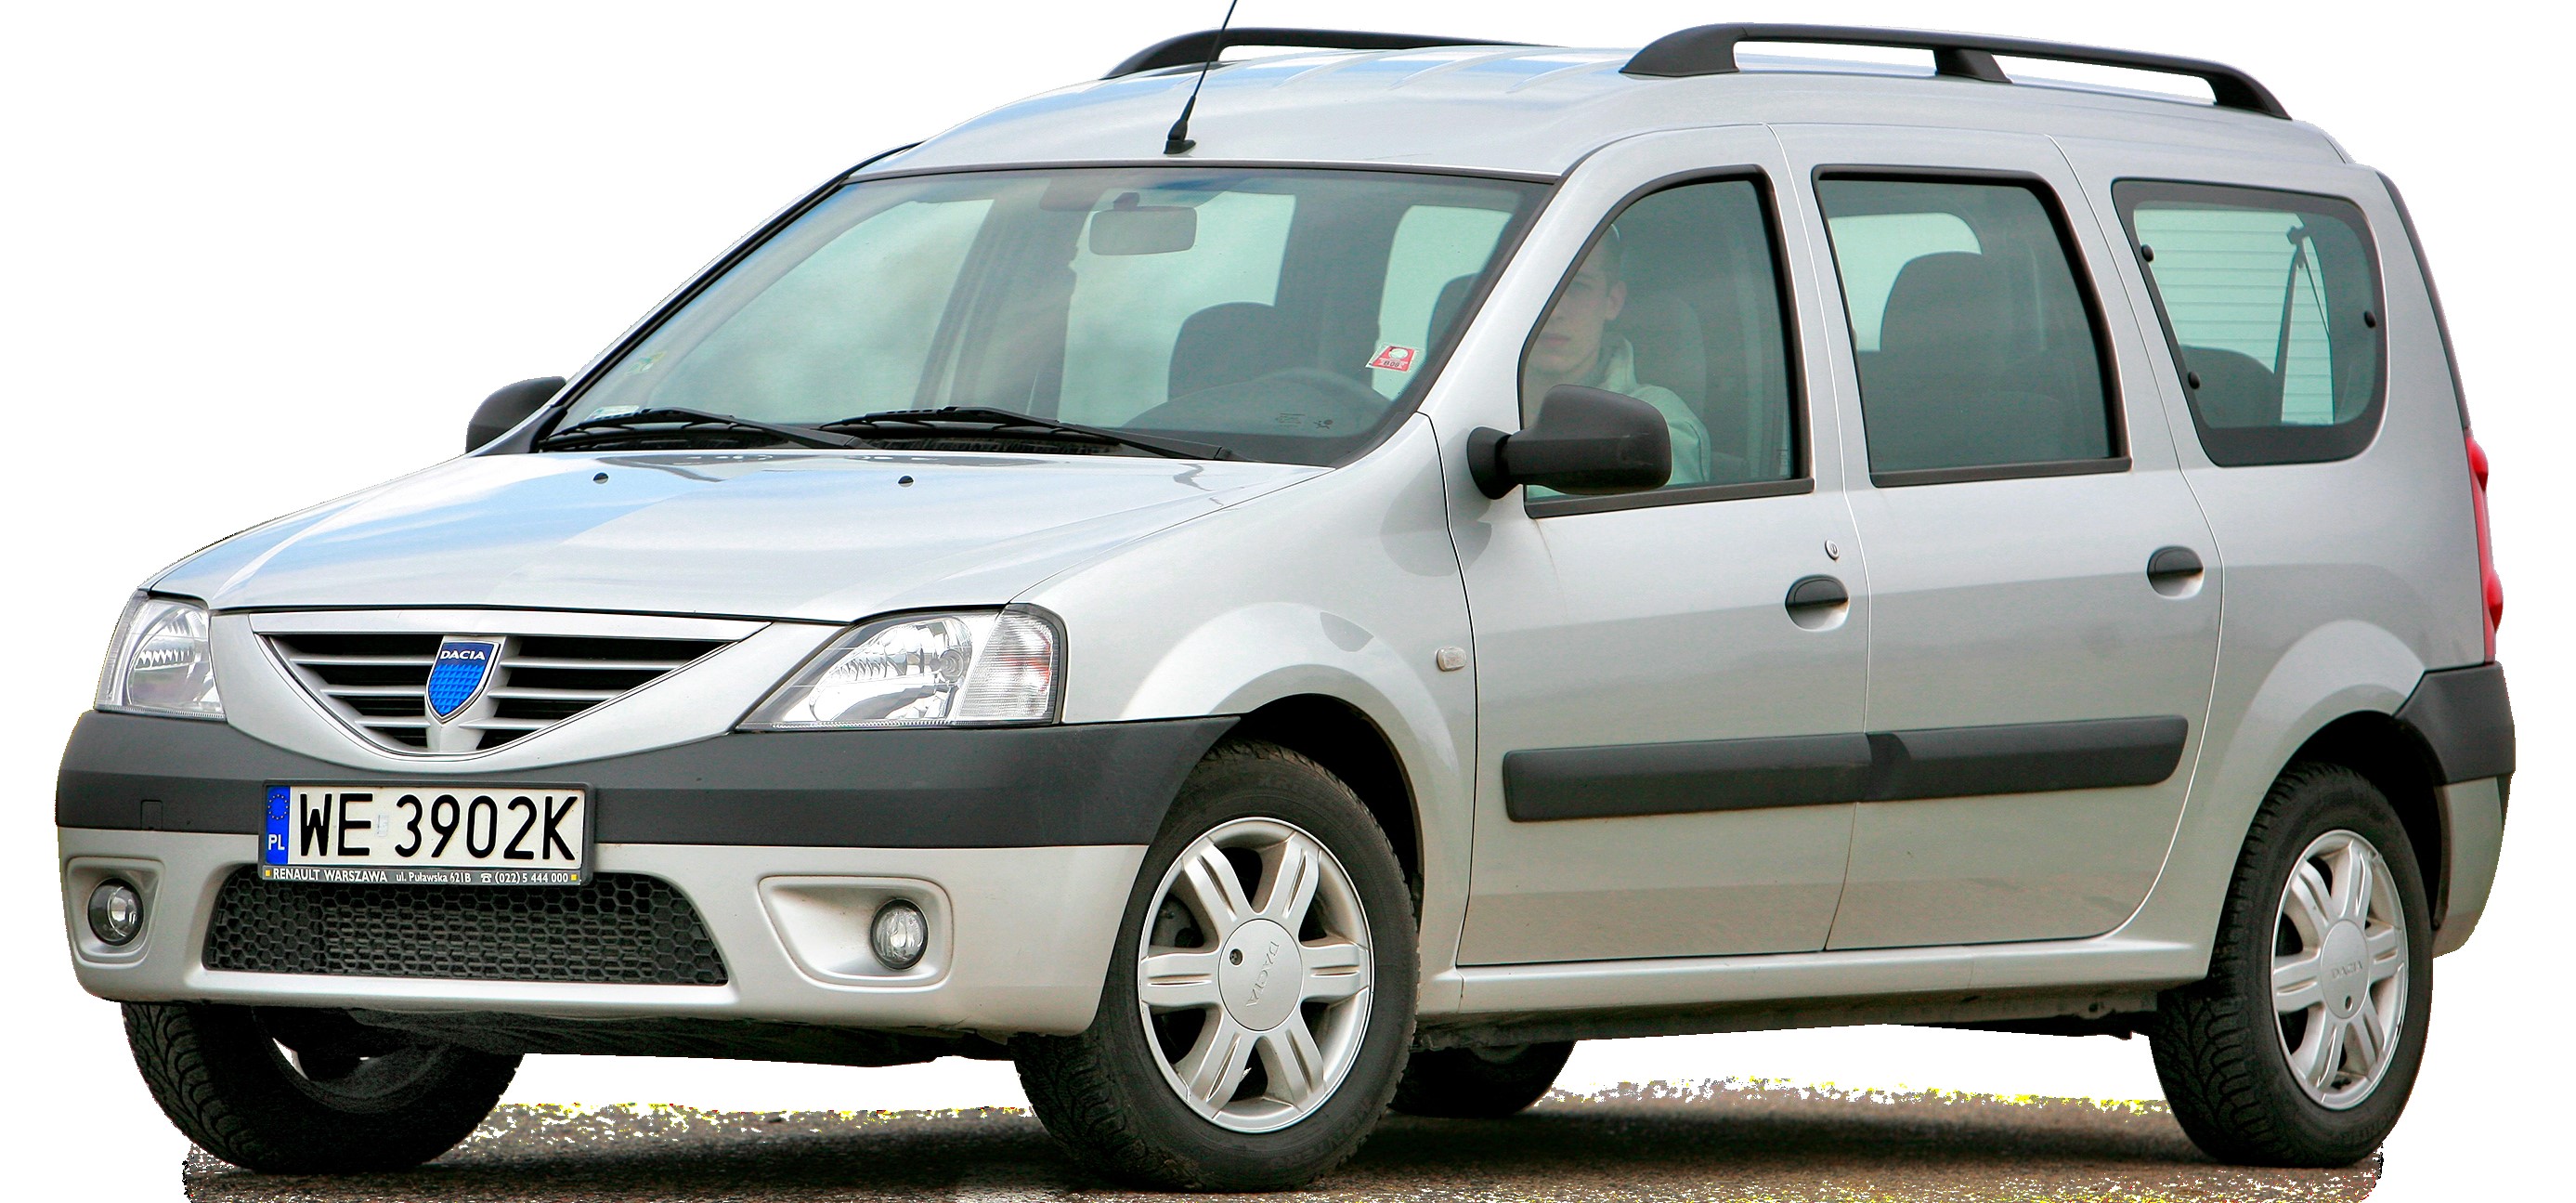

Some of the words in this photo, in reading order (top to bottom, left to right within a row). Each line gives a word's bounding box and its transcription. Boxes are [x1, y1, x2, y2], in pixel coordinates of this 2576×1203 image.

[440, 650, 486, 660] DACIA
[300, 793, 373, 856] WE
[395, 794, 579, 860] 3902K
[268, 834, 285, 850] PL
[273, 869, 320, 880] RENAULT
[324, 870, 387, 882] WARSZAWA
[396, 873, 407, 882] ul.
[409, 872, 448, 883] Puławska
[495, 871, 520, 883] (022)
[522, 873, 527, 883] 5
[531, 873, 548, 883] 444
[551, 873, 568, 883] 000
[1246, 941, 1279, 1007] DACIA
[2332, 961, 2363, 979] DACIA
